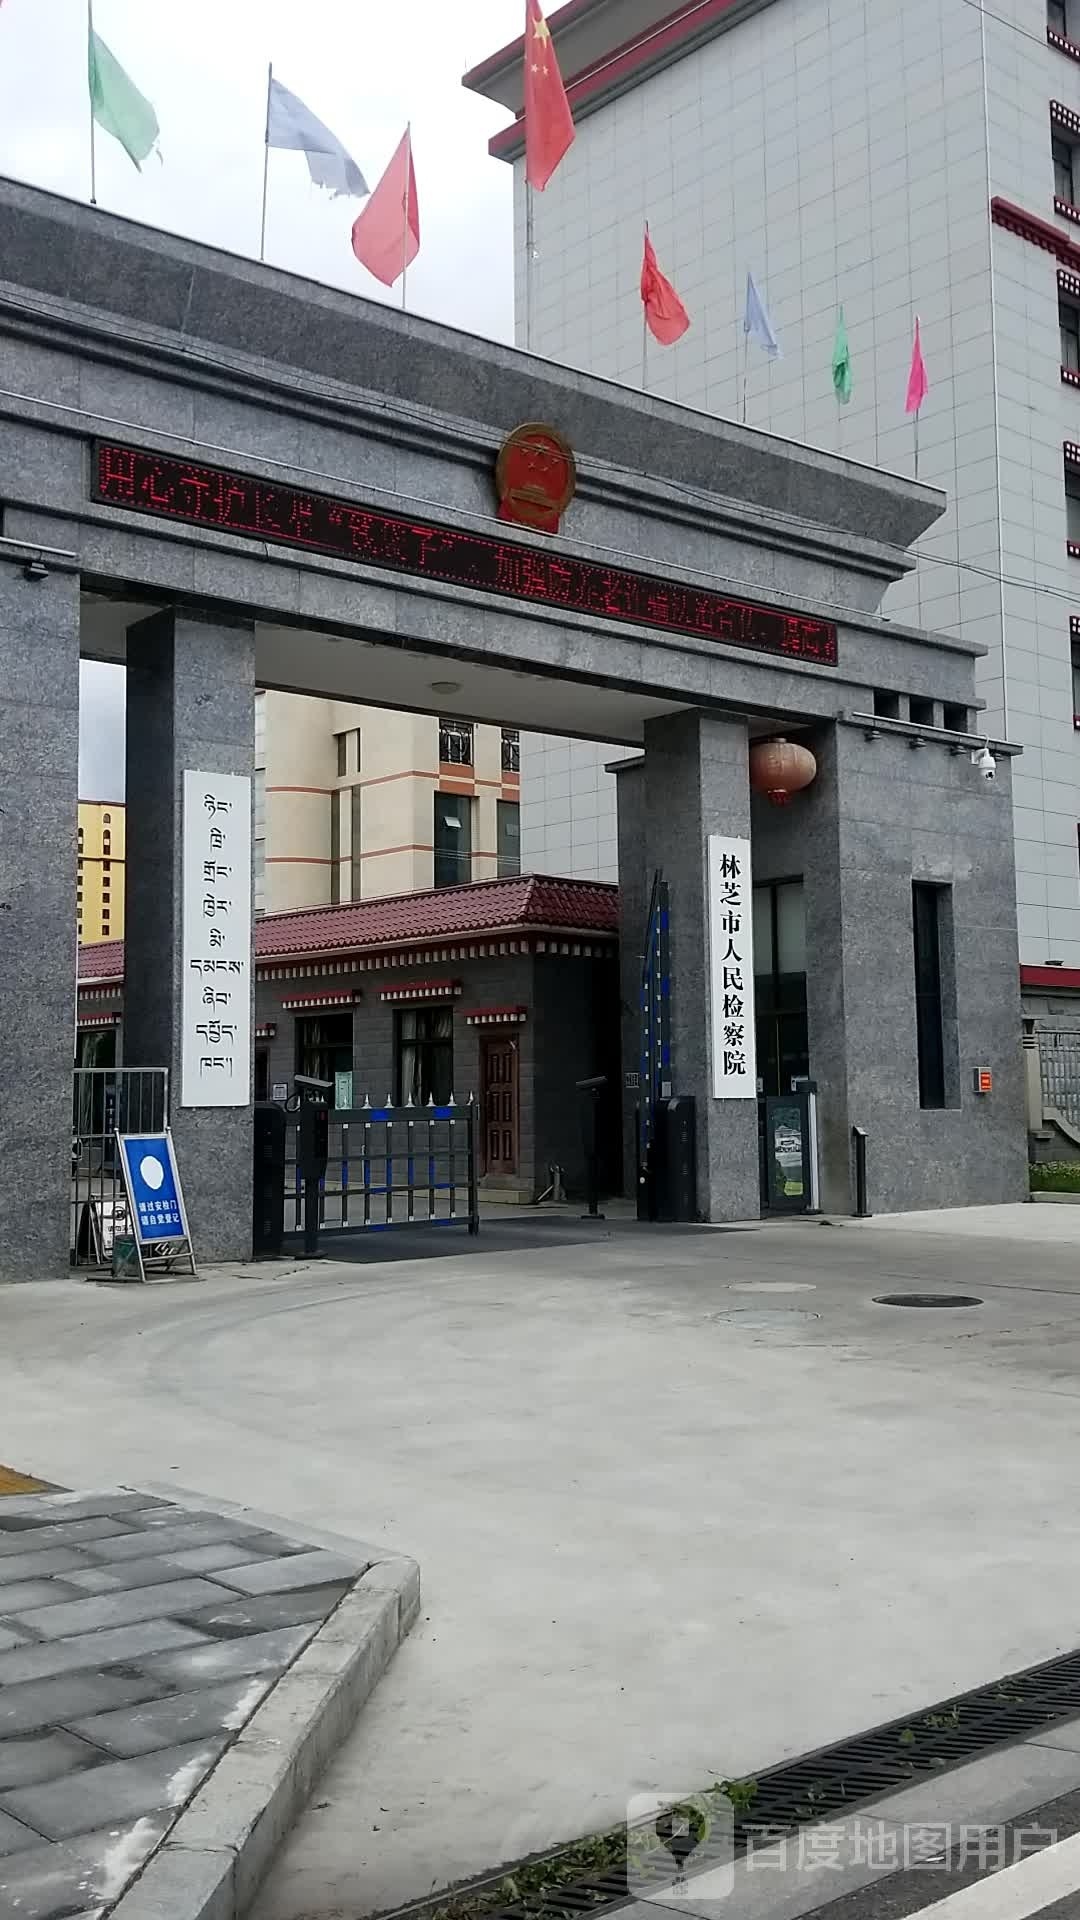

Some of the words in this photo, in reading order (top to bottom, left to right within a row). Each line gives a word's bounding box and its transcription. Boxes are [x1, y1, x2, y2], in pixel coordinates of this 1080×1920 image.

[719, 853, 746, 1076] 林芝市人民检察院
[138, 1199, 177, 1212] 请过安检门
